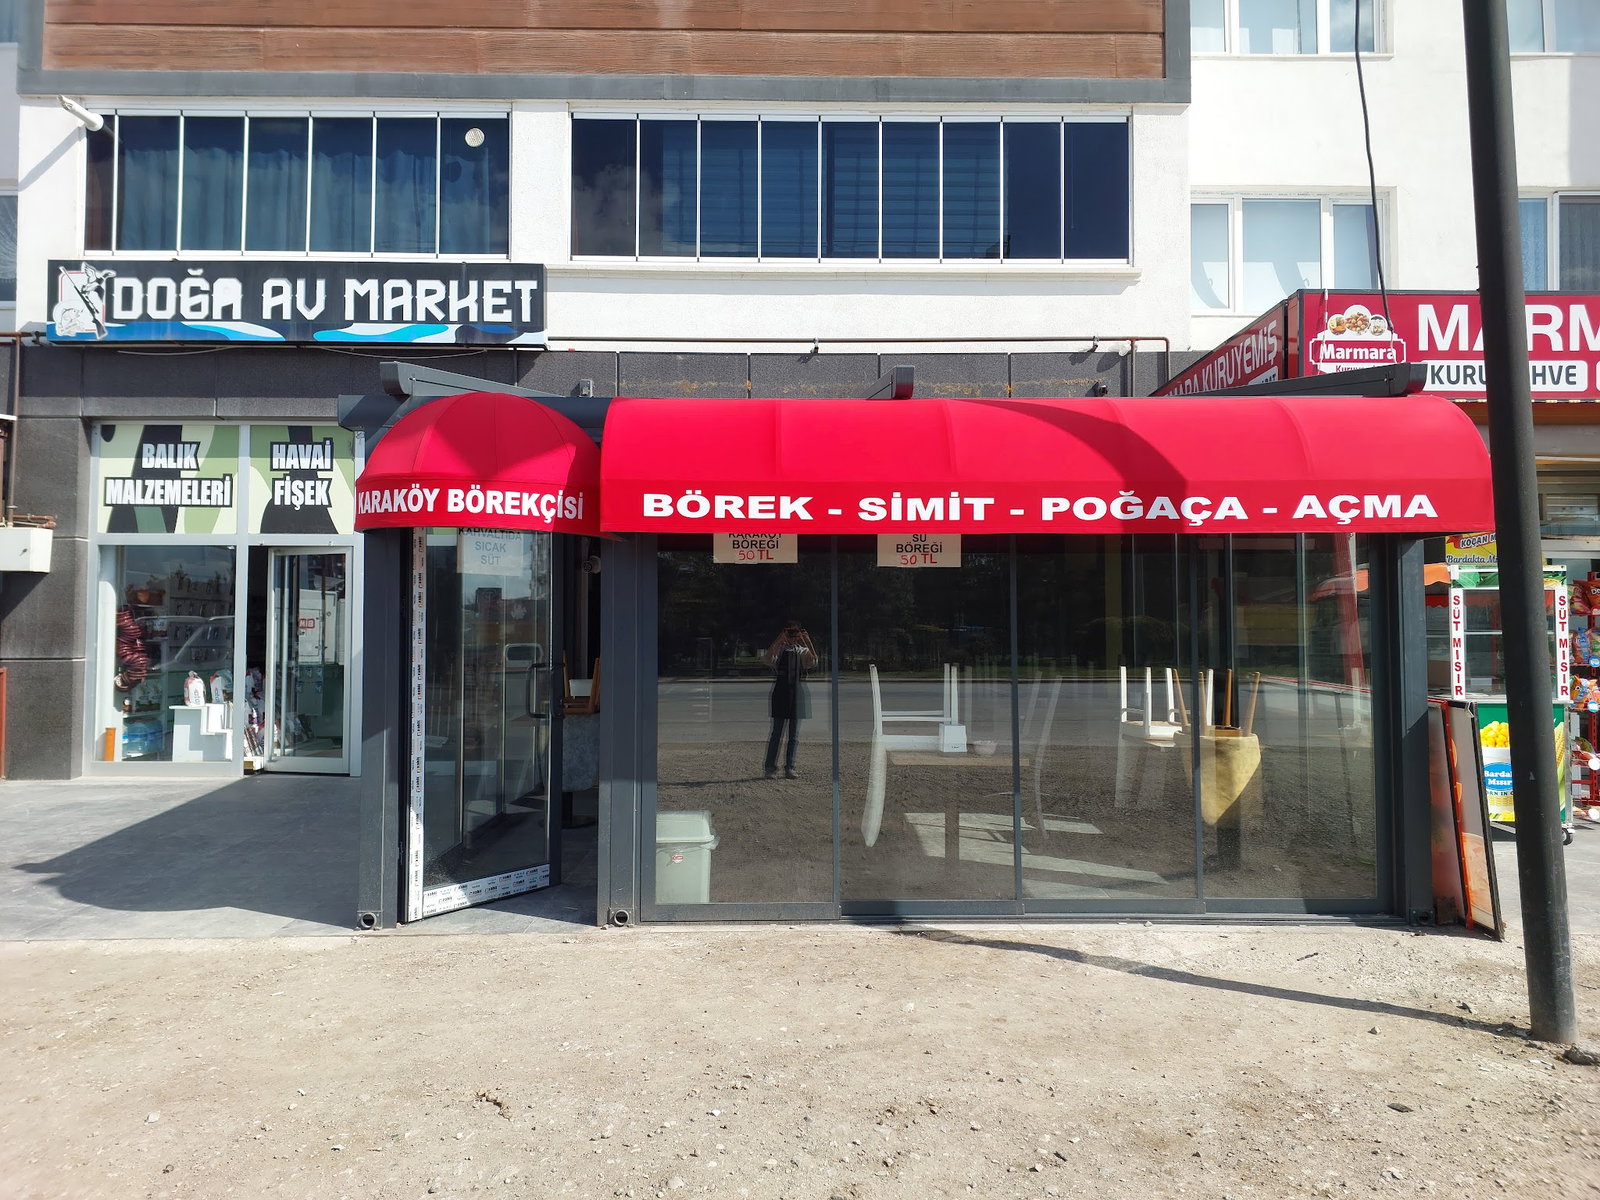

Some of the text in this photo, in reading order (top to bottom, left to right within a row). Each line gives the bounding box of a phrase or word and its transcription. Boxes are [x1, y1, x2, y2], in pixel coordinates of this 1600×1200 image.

[113, 269, 538, 322] DOĞA AV MARKET
[1418, 304, 1600, 352] MRM
[1320, 343, 1397, 360] Marmara
[142, 443, 197, 469] BALIK
[272, 440, 331, 470] HAVAİ
[105, 475, 231, 506] MALZEMELERİ
[274, 475, 329, 510] FİŞEK
[358, 483, 584, 524] KARAKÖY BÖREKÇİSİ
[642, 489, 814, 520] BÖREK
[857, 491, 995, 521] SİMİT
[1041, 490, 1249, 526] POĞAÇA
[1292, 494, 1438, 525] AÇMA
[474, 540, 507, 553] SICAK
[732, 537, 779, 549] BÖREĞİ
[738, 549, 774, 561] 50 TL
[896, 541, 943, 553] BÖREĞİ
[480, 554, 502, 566] SÜT
[900, 553, 938, 565] 50 TL
[1453, 595, 1463, 696] SÜT MISIR
[1558, 595, 1569, 696] SÜT MISIR
